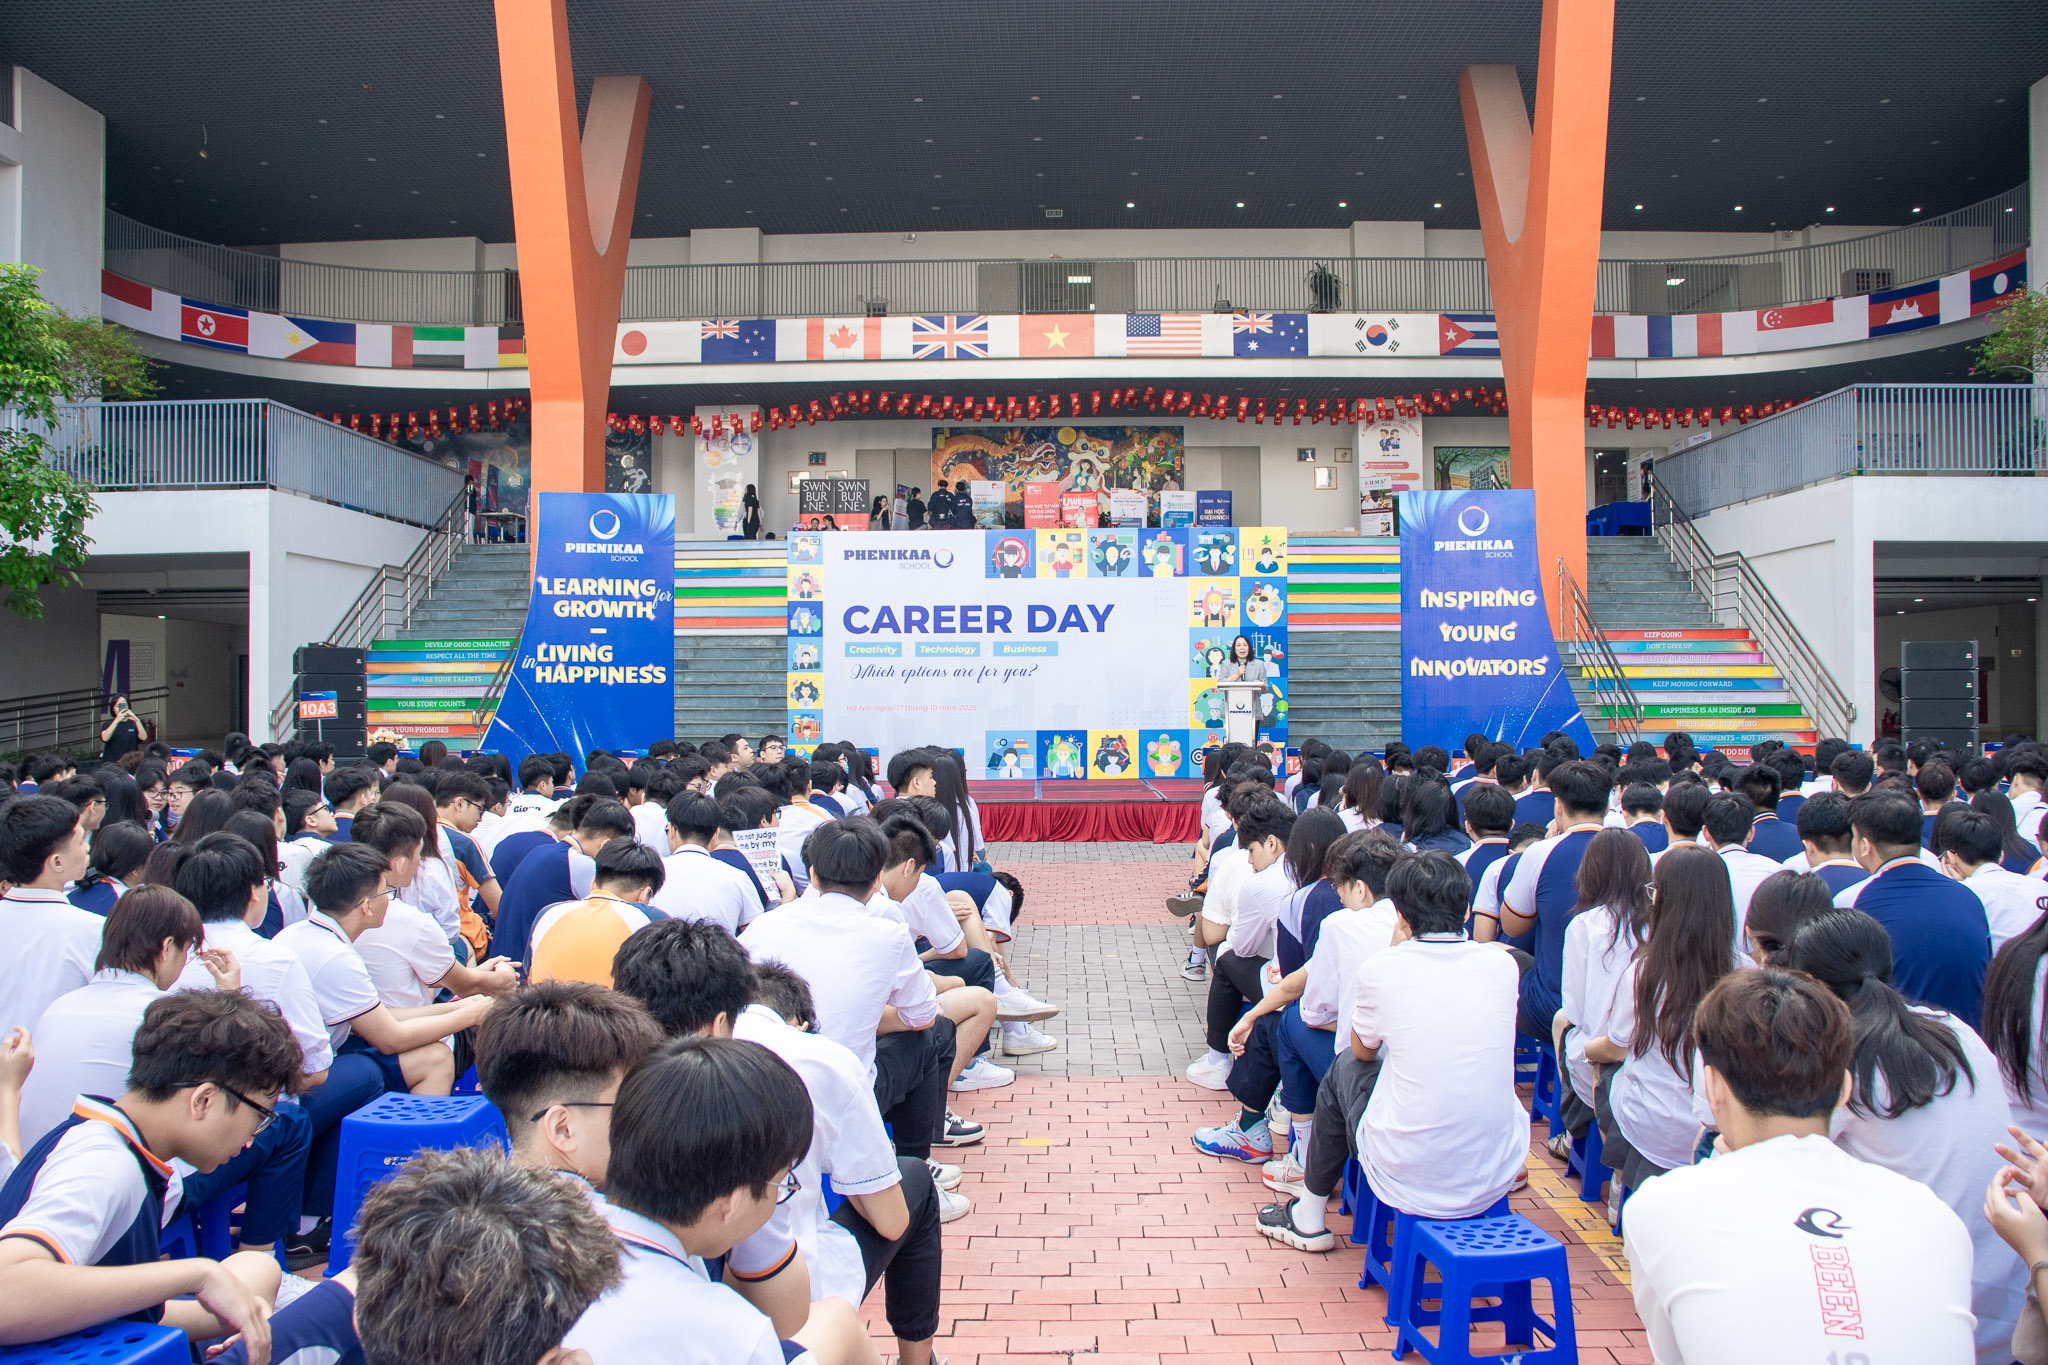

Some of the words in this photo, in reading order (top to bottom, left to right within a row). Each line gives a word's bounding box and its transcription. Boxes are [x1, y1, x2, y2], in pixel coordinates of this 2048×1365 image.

[806, 491, 828, 501] BUR
[841, 491, 864, 501] BUR
[565, 542, 645, 555] PHENIKAA
[1434, 539, 1515, 551] PHENIKAA
[843, 549, 932, 561] PHENIKAA
[540, 577, 656, 597] LEARNING
[652, 588, 674, 610] for
[1420, 590, 1536, 608] INSPIRING
[553, 600, 653, 619] GROWTH
[843, 604, 1013, 635] CAREER
[1026, 603, 1116, 634] DAY
[1439, 625, 1516, 642] YOUNG
[472, 640, 511, 648] CHARACTER
[849, 645, 898, 655] Creativity
[920, 645, 977, 655] Technology
[1003, 644, 1047, 653] Business
[536, 644, 613, 663] LIVING
[521, 654, 538, 669] in
[1410, 658, 1547, 677] INNOVATORS
[535, 666, 667, 684] HAPPINESS
[850, 663, 896, 680] Which
[901, 666, 948, 684] options
[952, 668, 975, 677] are
[976, 665, 999, 684] for
[1003, 663, 1039, 683] you?
[301, 702, 336, 716] 10A3
[755, 831, 777, 841] judge
[750, 841, 760, 850] by
[762, 840, 776, 848] my
[768, 859, 778, 868] by
[1809, 1243, 1865, 1340] BEEN
